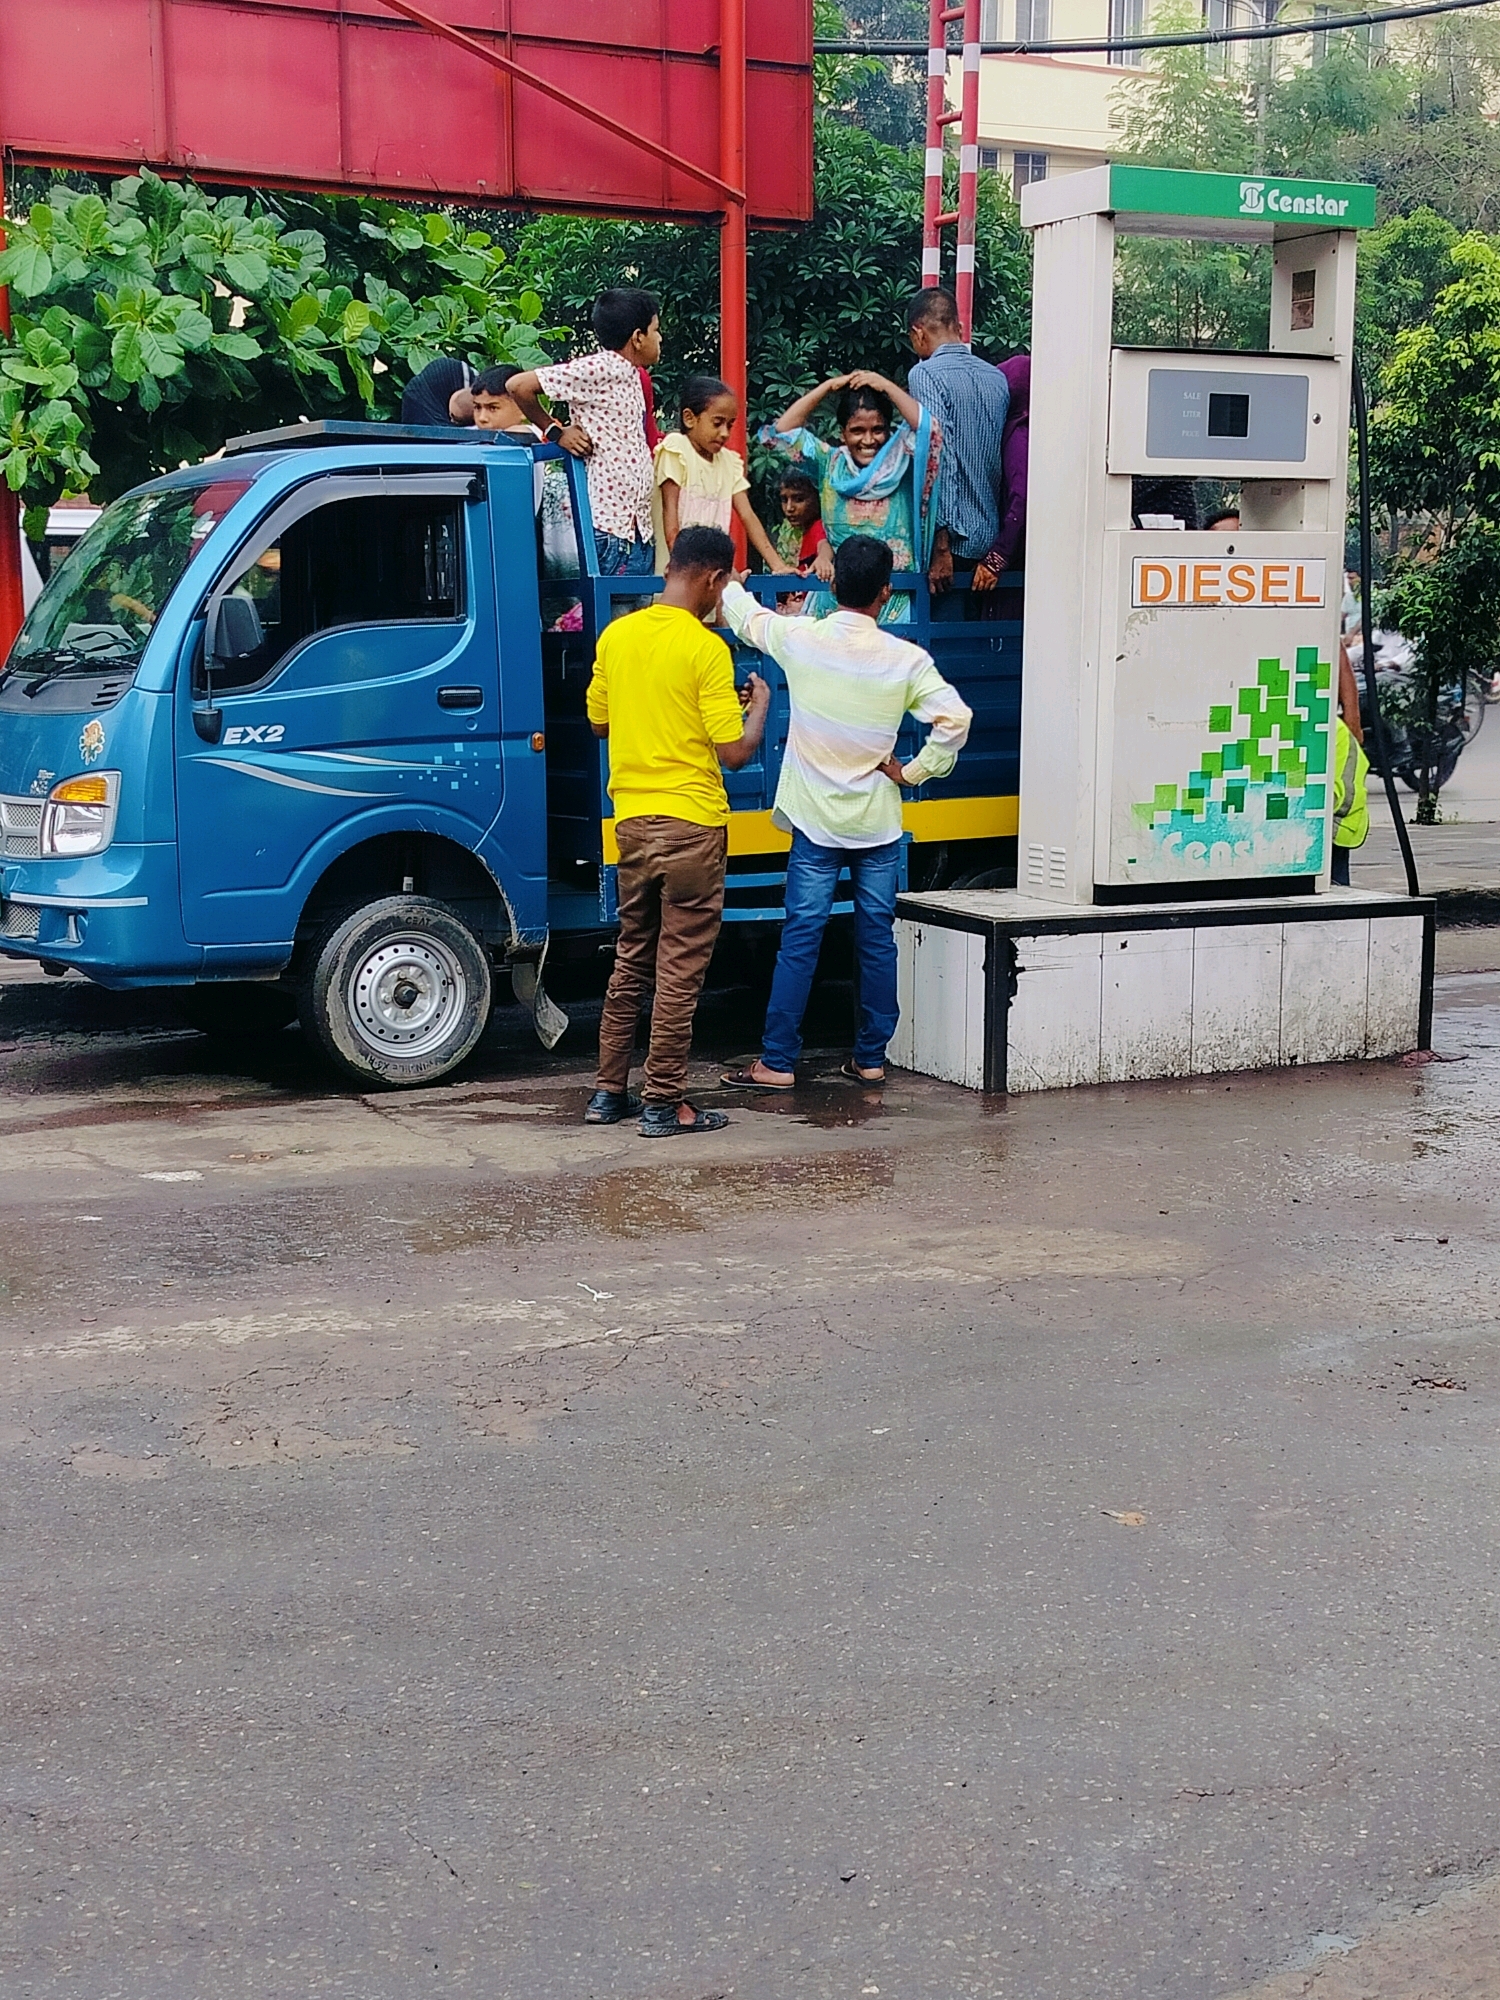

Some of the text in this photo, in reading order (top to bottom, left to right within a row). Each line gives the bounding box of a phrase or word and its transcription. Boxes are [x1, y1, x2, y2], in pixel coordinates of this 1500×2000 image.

[1267, 188, 1349, 217] Censtar
[1183, 391, 1202, 400] SALE
[1138, 563, 1322, 604] DIESEL
[222, 724, 285, 746] EX2
[1160, 830, 1314, 868] Censtar
[405, 916, 432, 926] CEAT
